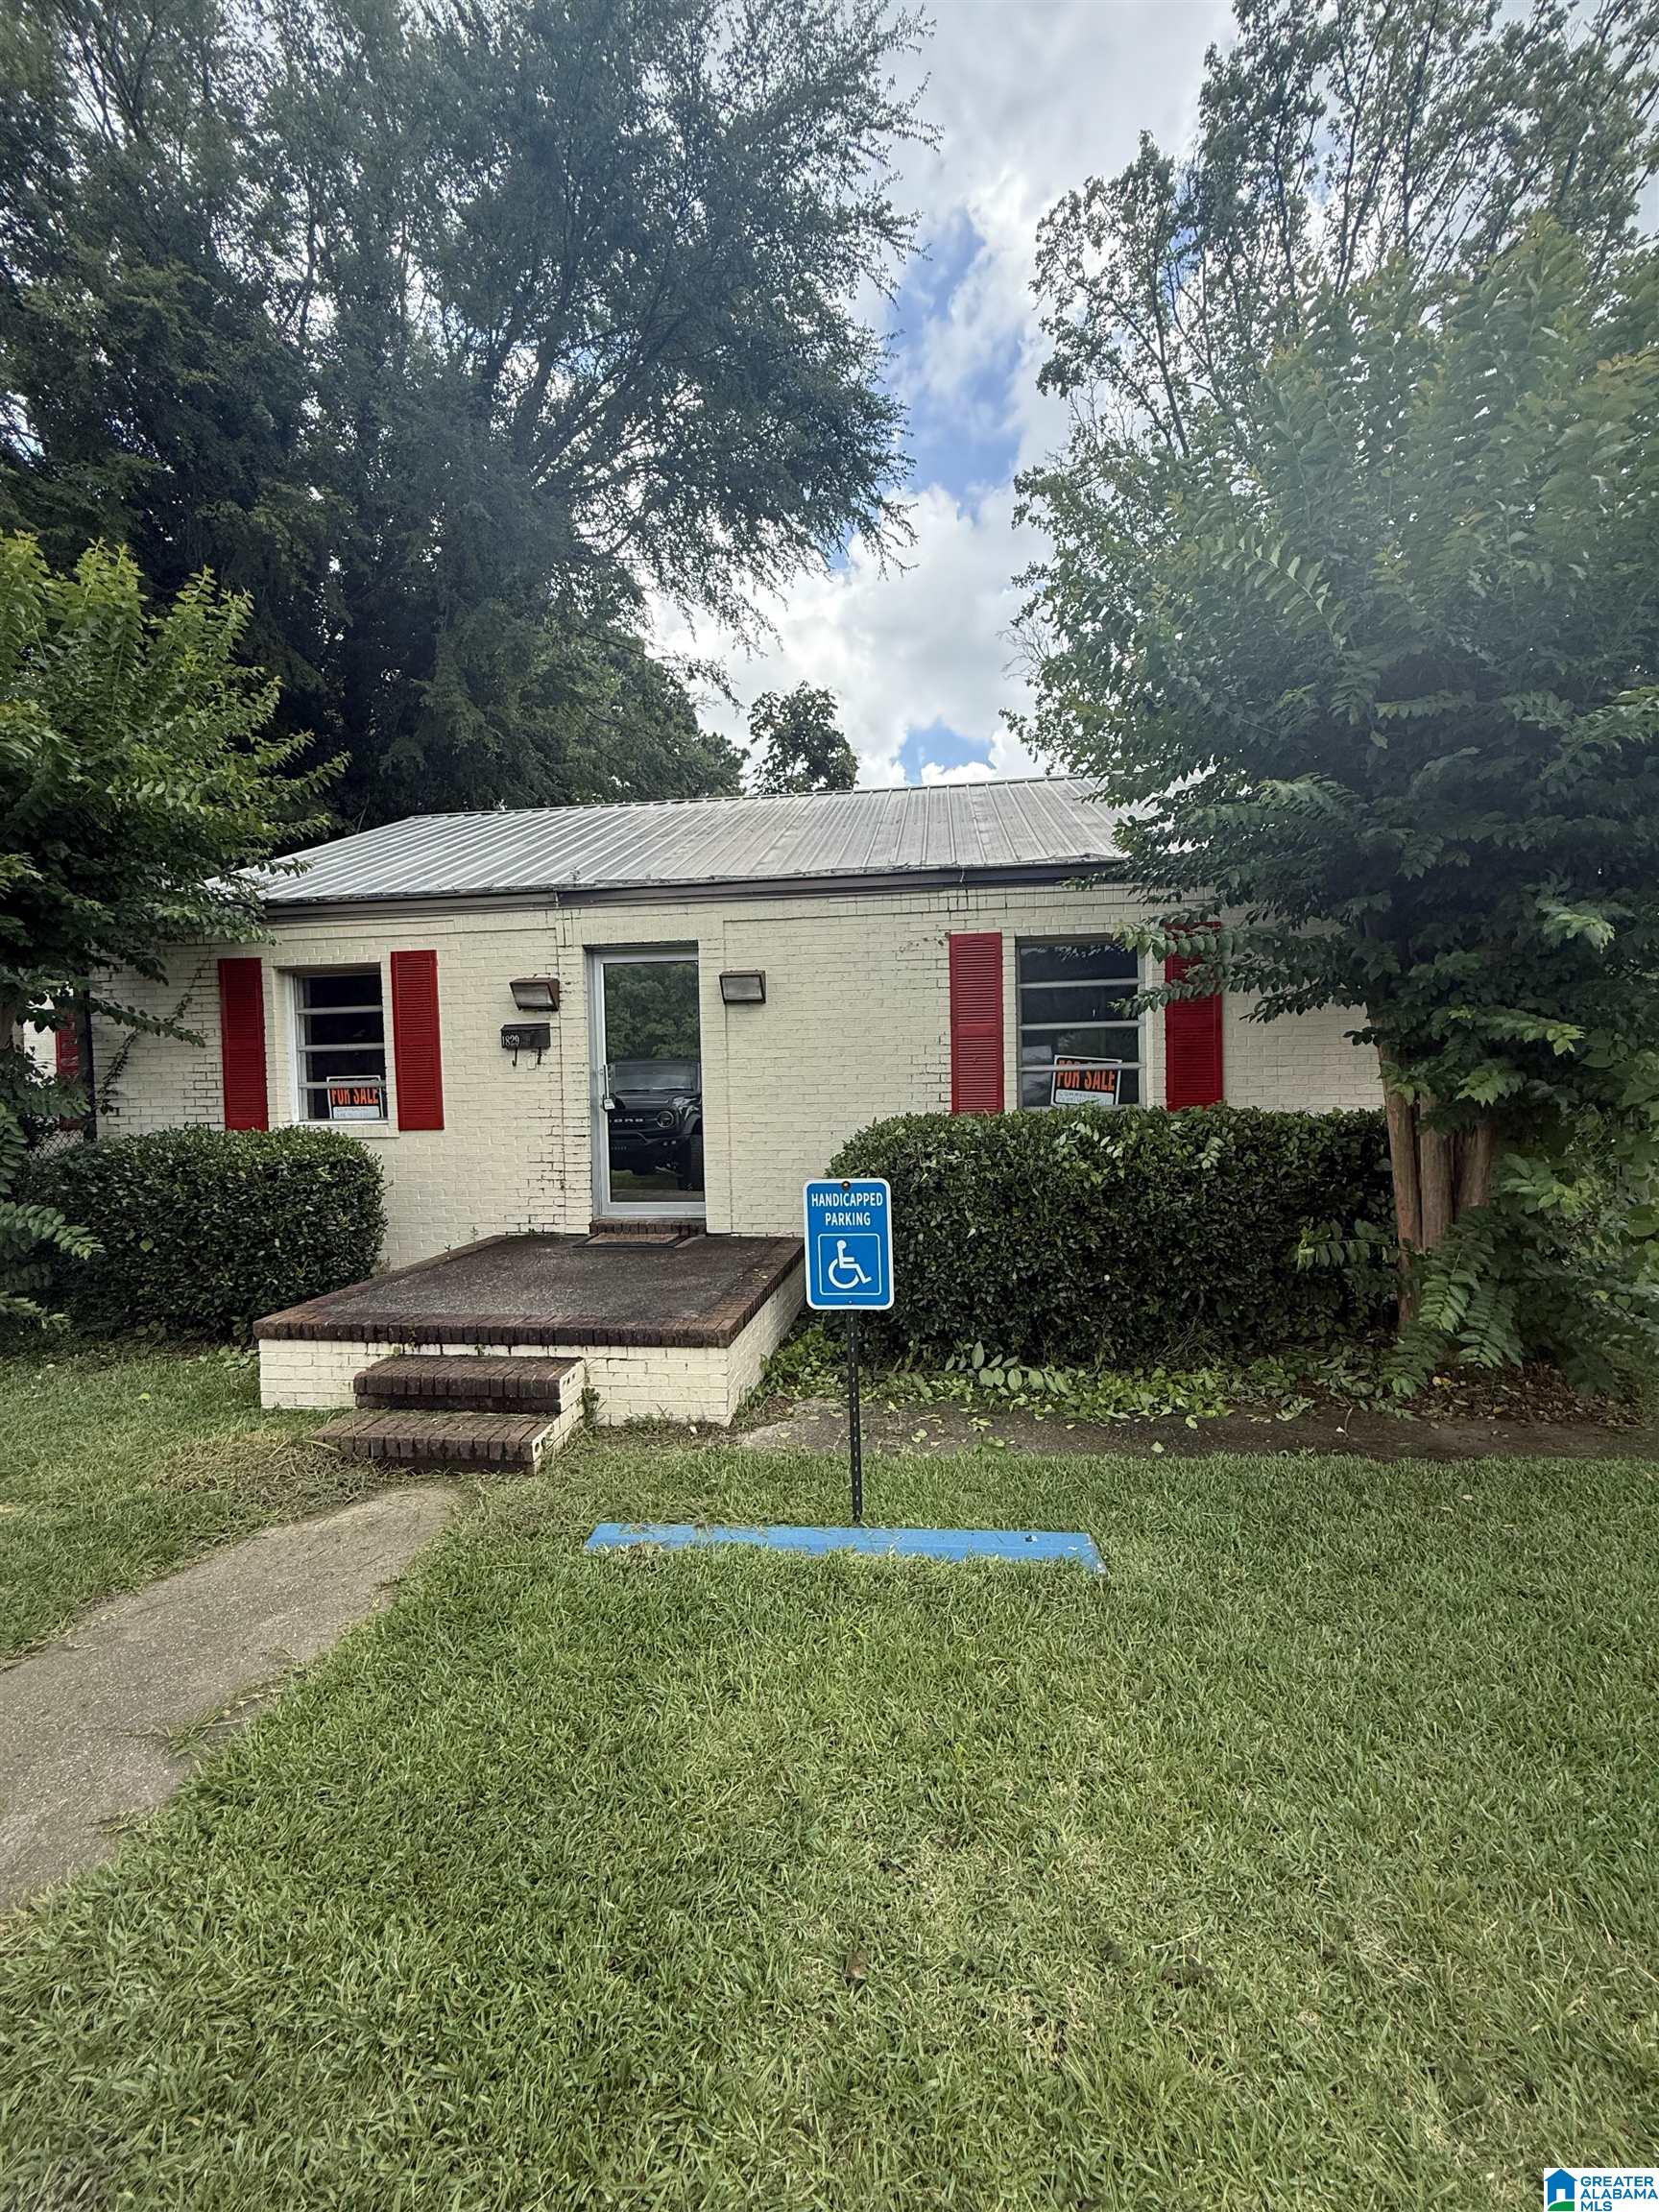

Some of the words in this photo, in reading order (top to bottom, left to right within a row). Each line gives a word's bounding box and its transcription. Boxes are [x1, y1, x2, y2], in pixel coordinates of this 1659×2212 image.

[502, 1035, 520, 1046] 1829
[1057, 1059, 1081, 1089] FOR
[1084, 1062, 1116, 1092] SALE
[330, 1087, 351, 1106] FOR
[353, 1087, 379, 1105] SALE
[811, 1192, 883, 1207] HANDICAPPED
[825, 1212, 871, 1227] PARKING
